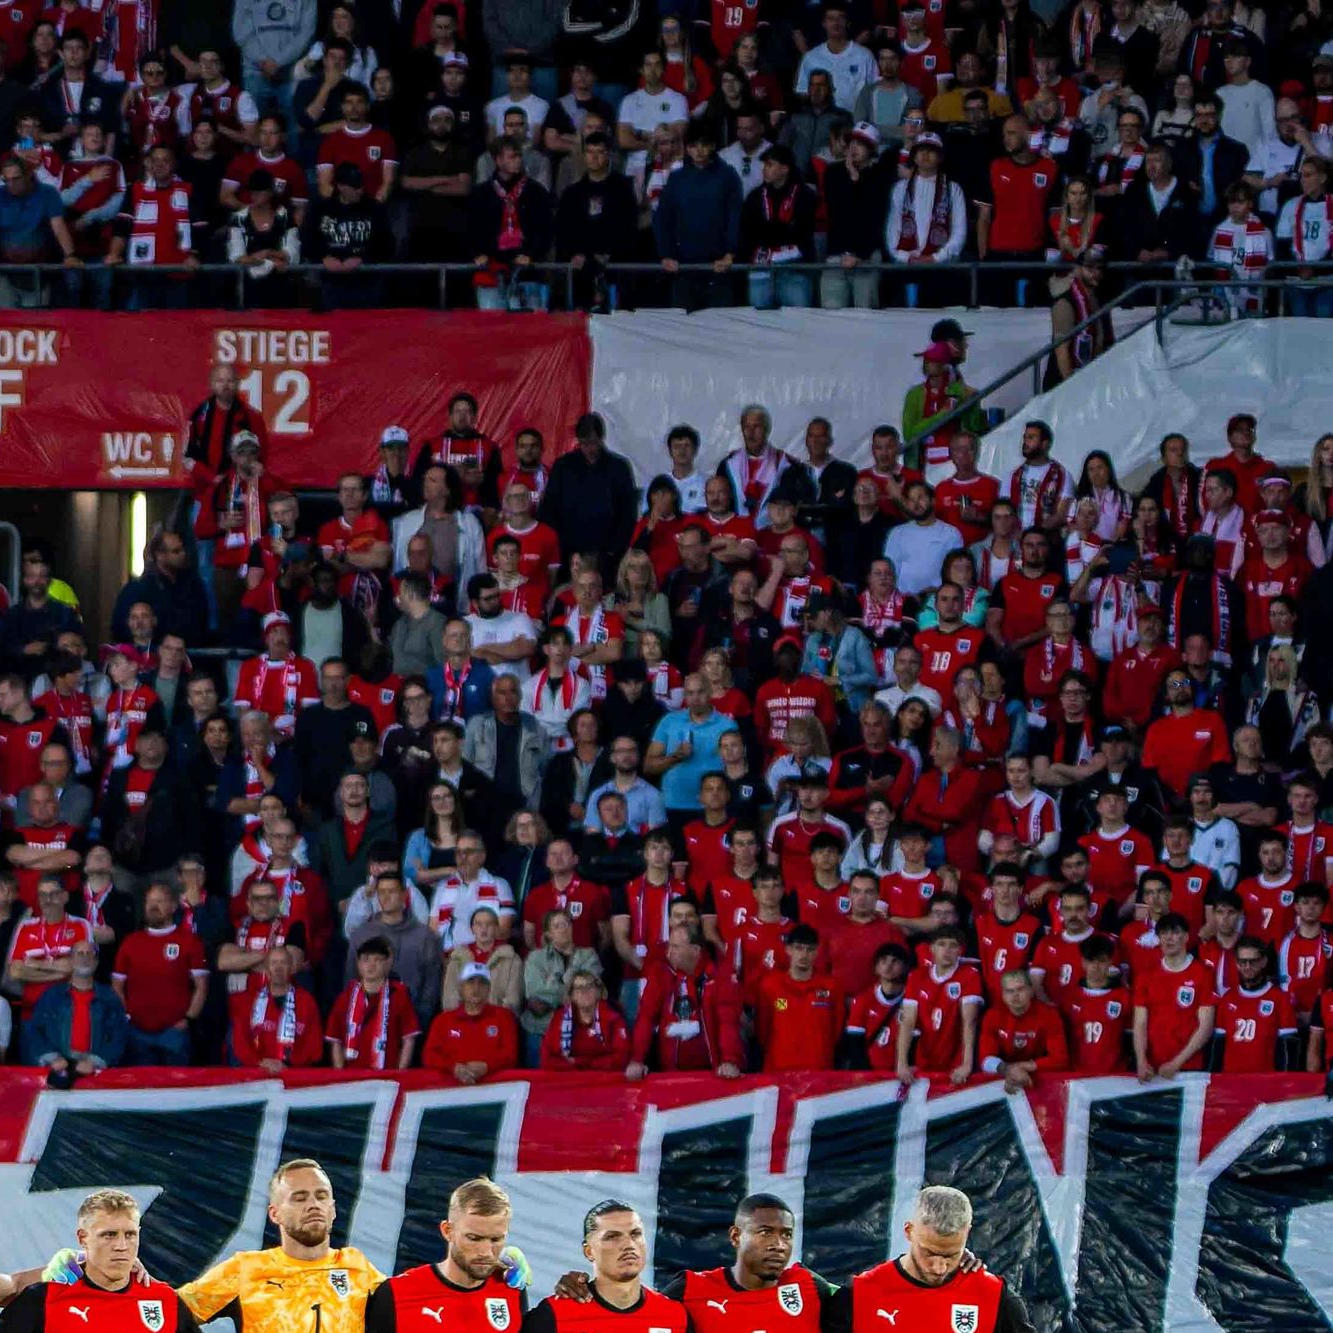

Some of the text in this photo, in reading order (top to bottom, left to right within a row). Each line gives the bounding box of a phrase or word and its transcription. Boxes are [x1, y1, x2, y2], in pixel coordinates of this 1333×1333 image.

[216, 330, 331, 363] STIEGE
[238, 368, 311, 434] 12
[104, 432, 153, 463] WC
[1260, 907, 1274, 929] 7
[994, 948, 1007, 972] 6
[1084, 1021, 1104, 1044] 19
[1234, 1018, 1257, 1043] 20
